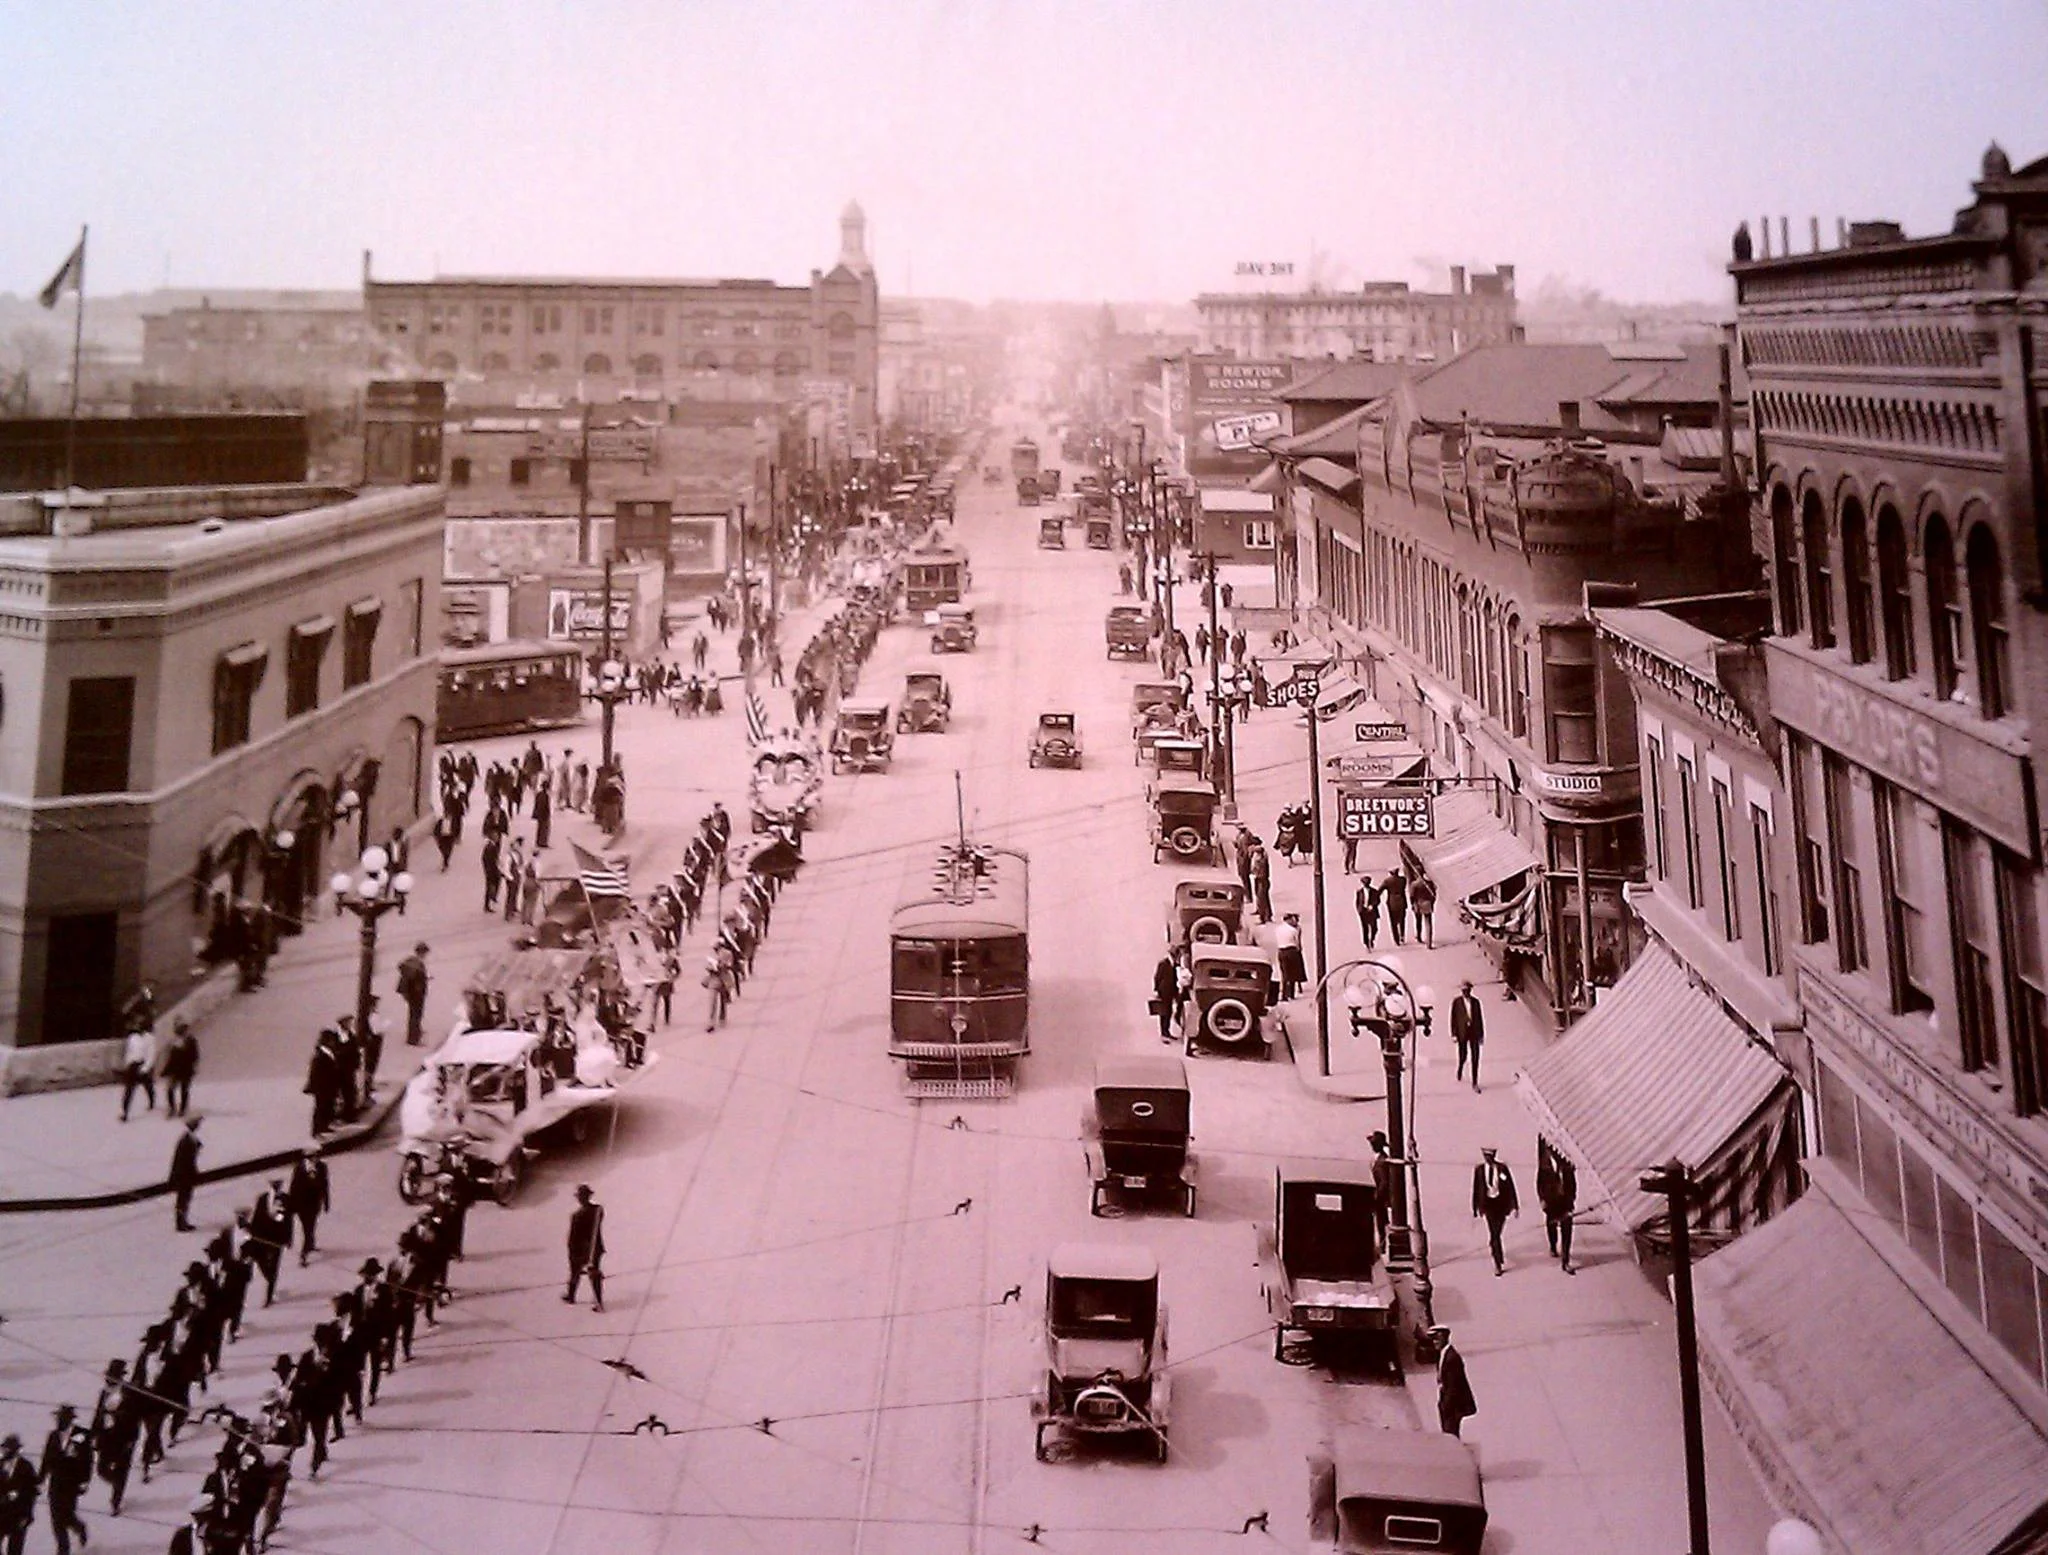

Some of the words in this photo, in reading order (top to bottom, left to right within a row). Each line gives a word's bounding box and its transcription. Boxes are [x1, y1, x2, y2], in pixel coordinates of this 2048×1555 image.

[1267, 681, 1317, 706] SHOES
[1342, 763, 1392, 773] ROOMS
[1546, 777, 1599, 790] STUDIO
[1345, 814, 1429, 832] SHOES
